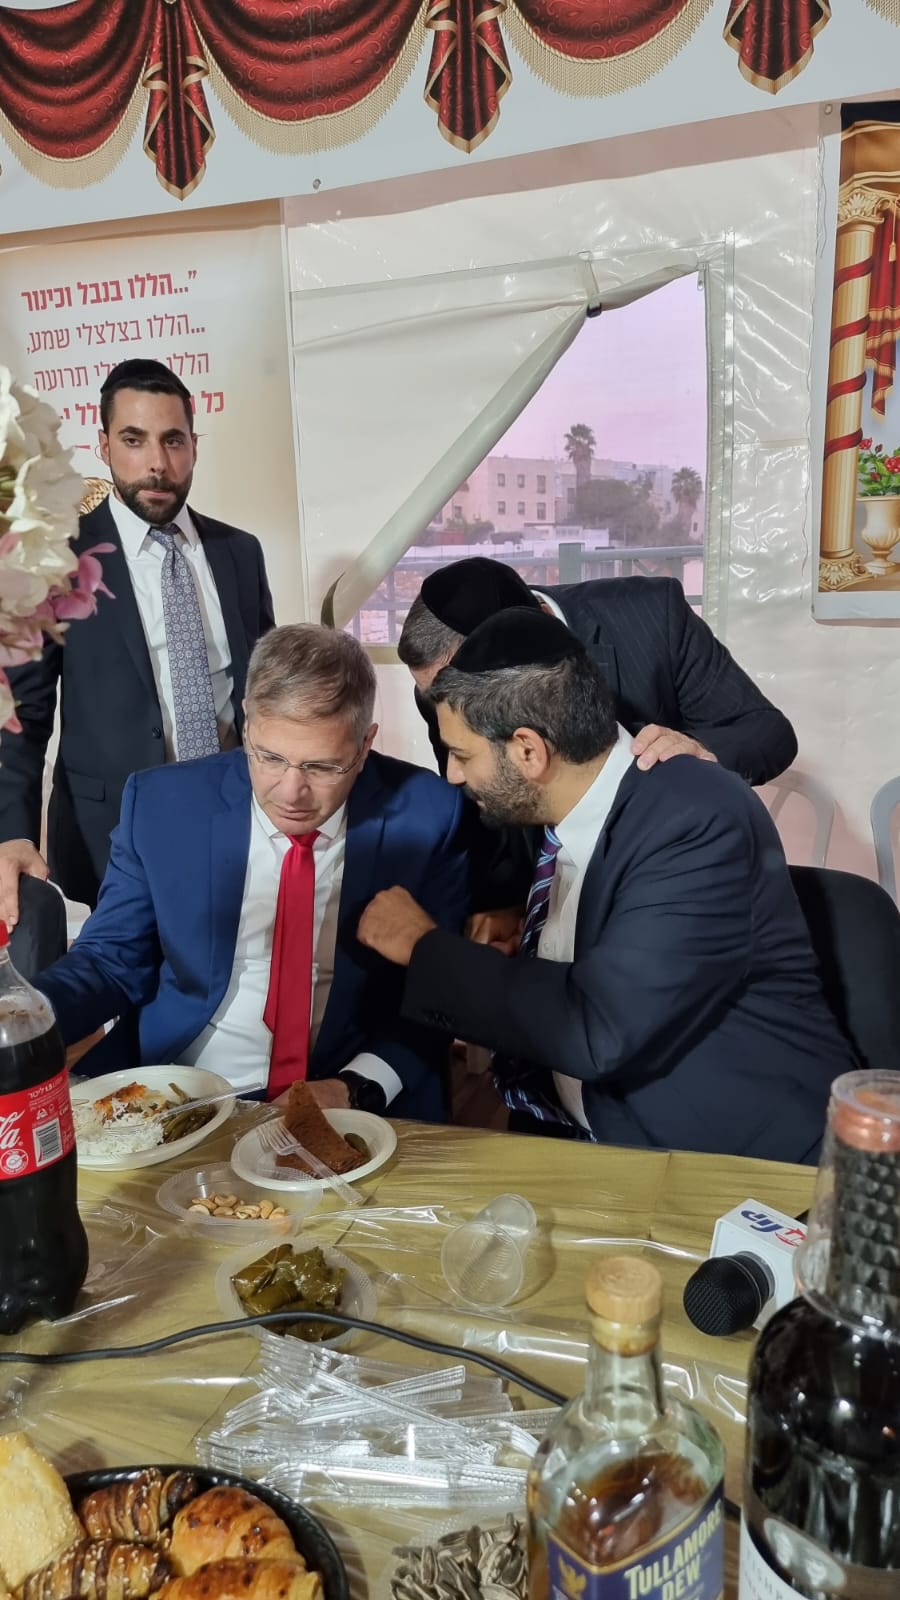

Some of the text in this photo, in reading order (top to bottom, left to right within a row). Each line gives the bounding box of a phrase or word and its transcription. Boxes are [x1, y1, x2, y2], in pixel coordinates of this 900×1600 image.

[21, 286, 73, 312] וכינור
[76, 281, 123, 305] בנבל
[76, 320, 142, 346] בצלצלי
[34, 365, 88, 391] תרועה
[200, 391, 225, 413] כל
[662, 1553, 700, 1600] DEW
